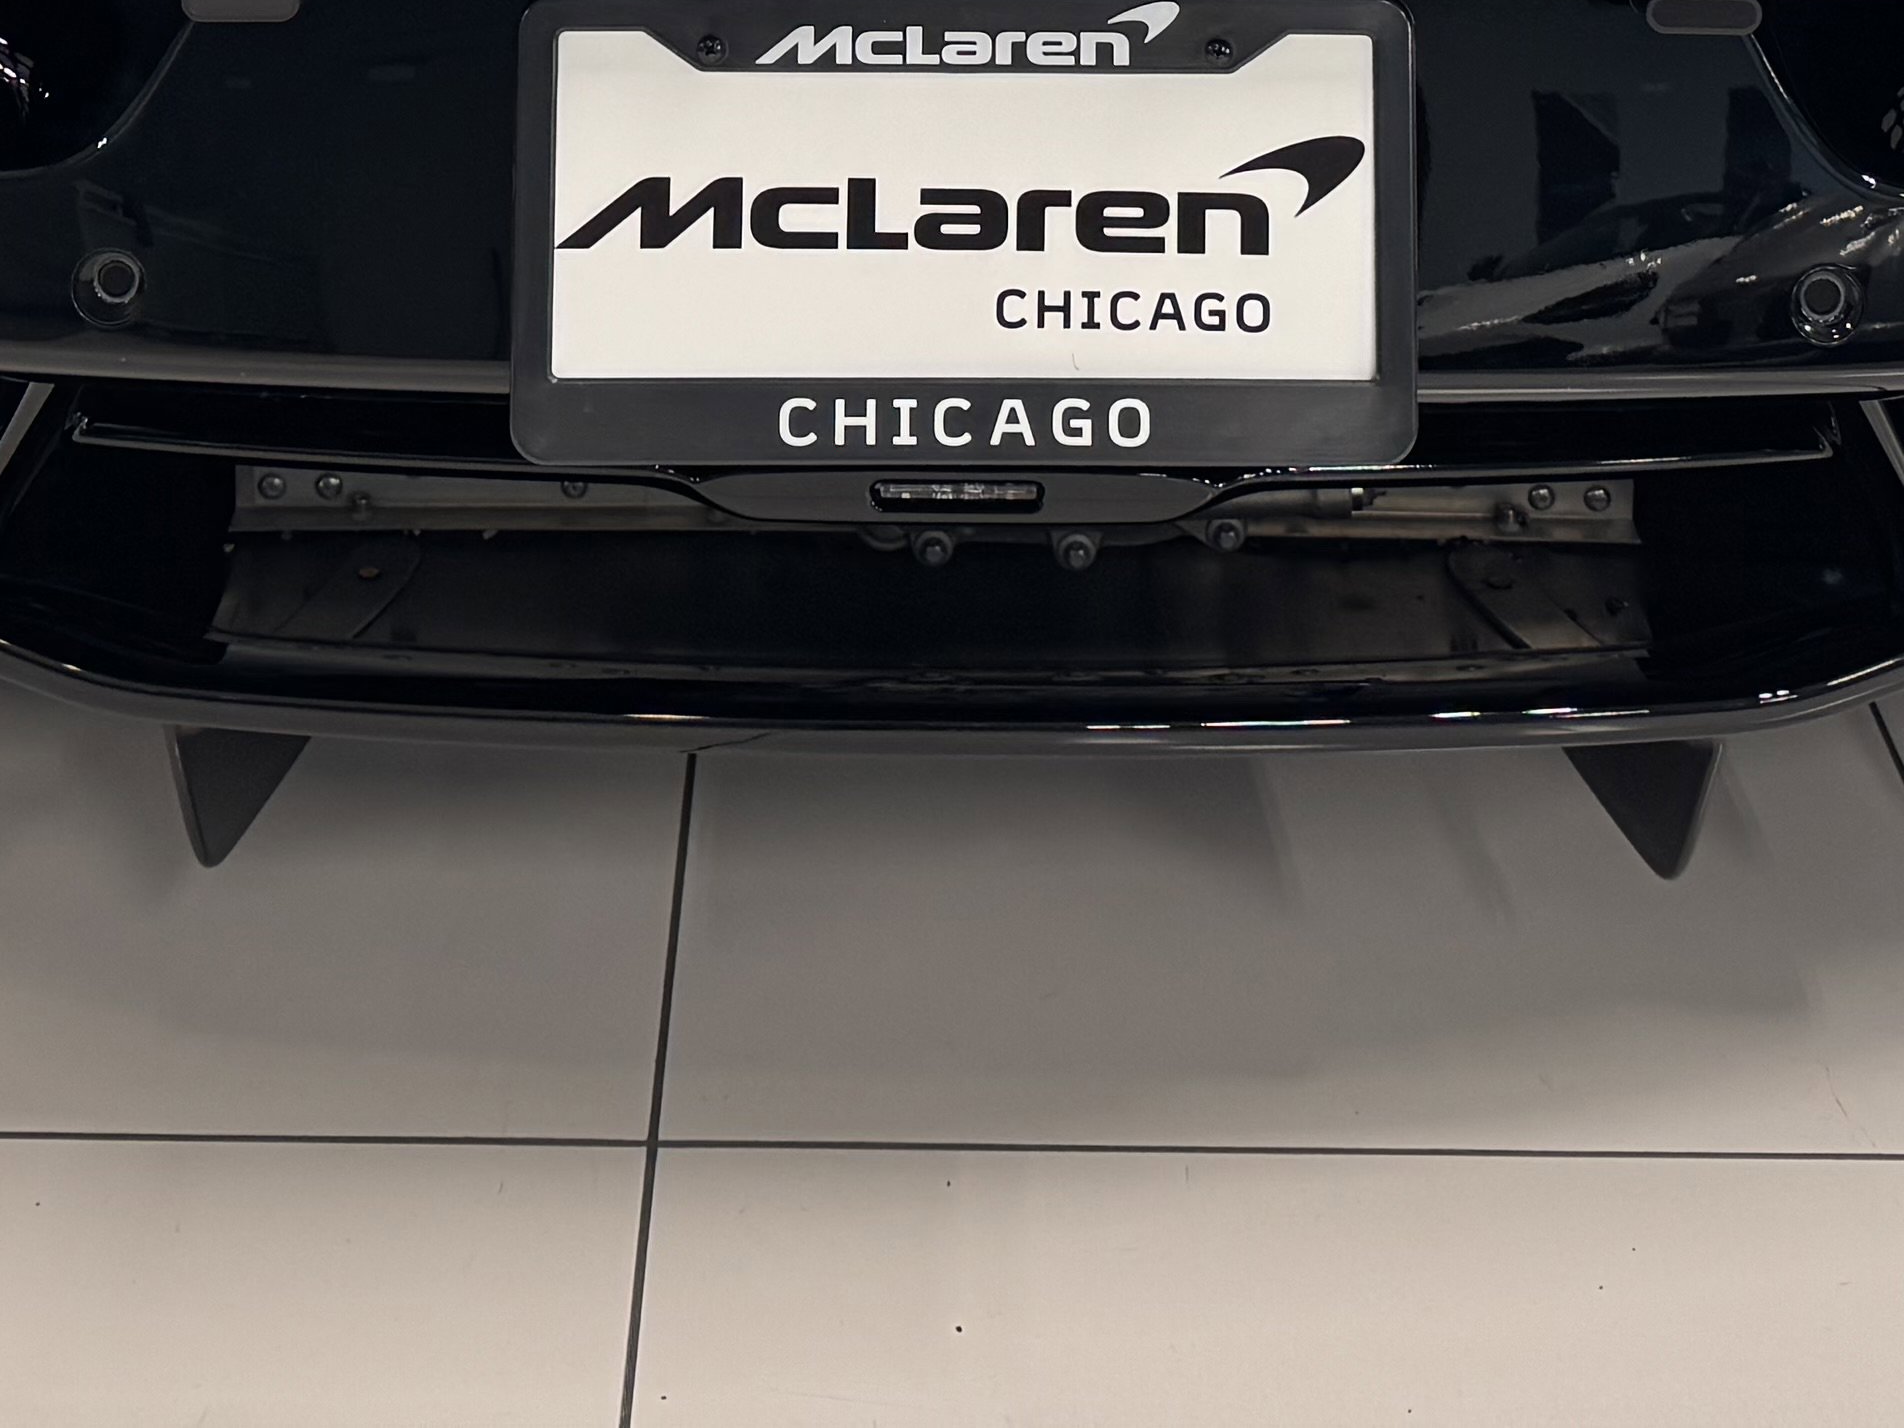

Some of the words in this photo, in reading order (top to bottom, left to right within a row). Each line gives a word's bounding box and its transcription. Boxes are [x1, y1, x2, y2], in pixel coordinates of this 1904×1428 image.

[755, 25, 1131, 66] McLaren
[555, 176, 1271, 257] McLaren
[995, 288, 1272, 334] CHICAGO
[777, 396, 1153, 448] CHICAGO
